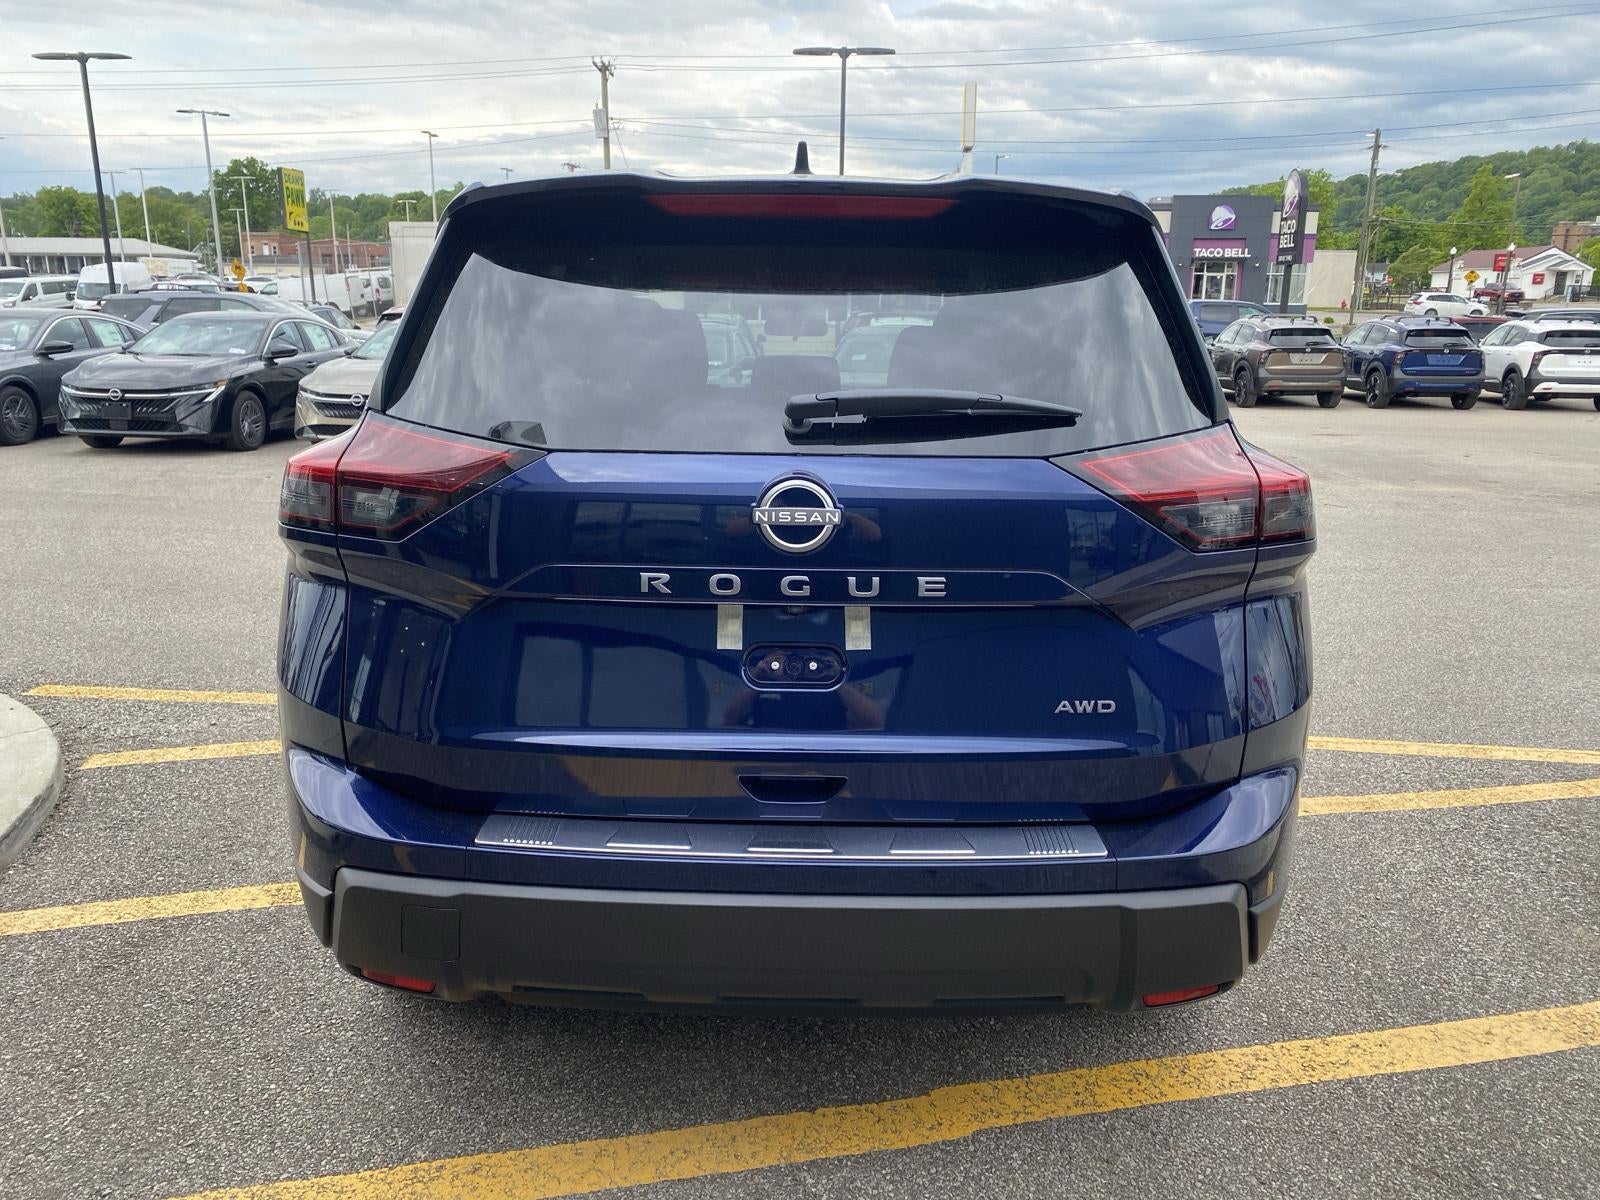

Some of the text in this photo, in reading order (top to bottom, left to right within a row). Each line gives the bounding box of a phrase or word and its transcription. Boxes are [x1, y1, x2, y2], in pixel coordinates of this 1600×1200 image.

[286, 186, 306, 208] PAWN
[1280, 219, 1296, 234] TACO
[1279, 233, 1295, 248] BELL
[1193, 248, 1252, 258] TACO BELL
[755, 510, 839, 523] NISSAN
[639, 572, 947, 597] ROGUE
[1053, 700, 1117, 714] AWD
